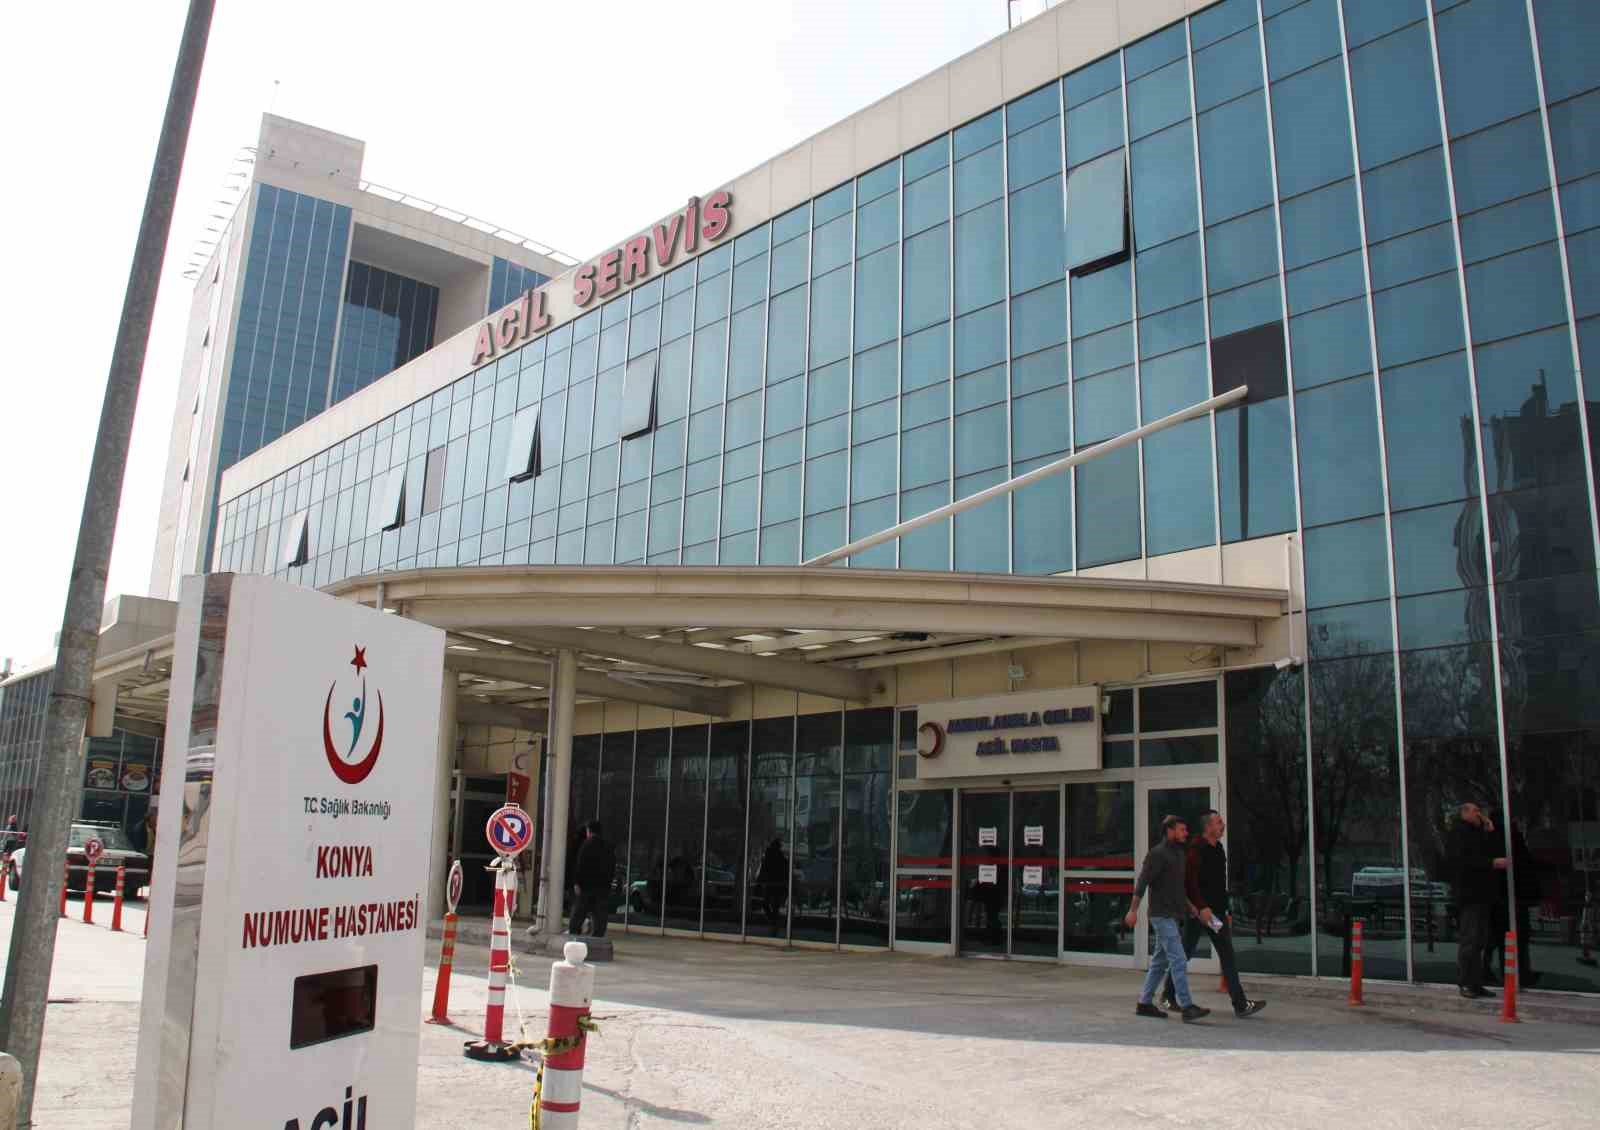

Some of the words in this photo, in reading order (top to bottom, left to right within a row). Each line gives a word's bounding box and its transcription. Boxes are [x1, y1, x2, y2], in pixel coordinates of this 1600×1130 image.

[472, 288, 552, 365] ACİL
[574, 191, 732, 308] SERVİS
[320, 797, 350, 818] Sağlık
[351, 799, 391, 820] Bakanlığı
[316, 846, 374, 878] KONYA
[242, 907, 329, 949] NUMUNE
[333, 893, 419, 939] HASTANESİ
[284, 1085, 367, 1130] İL
